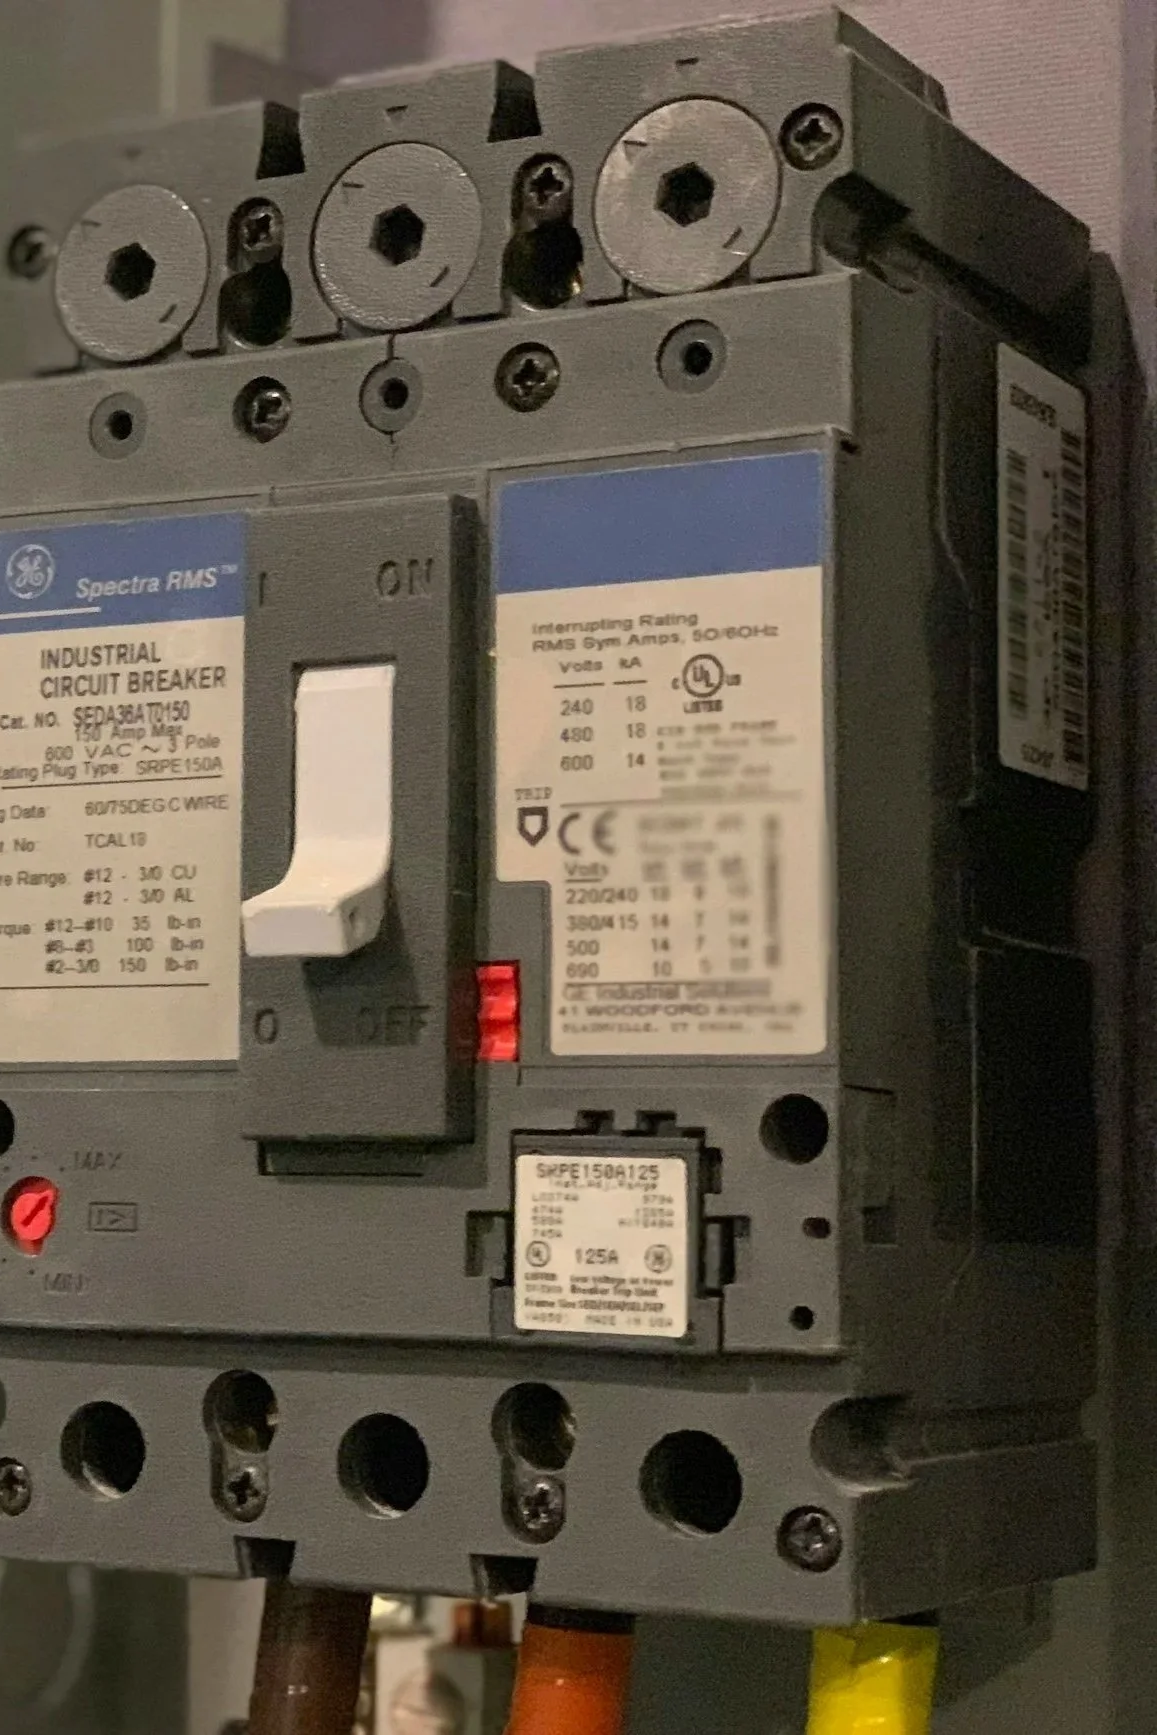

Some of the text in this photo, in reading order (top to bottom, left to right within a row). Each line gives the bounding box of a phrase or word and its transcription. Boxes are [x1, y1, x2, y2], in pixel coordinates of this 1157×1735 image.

[376, 557, 436, 597] ON
[75, 574, 160, 601] Spectra
[531, 612, 700, 636] Interrupting Rating
[531, 638, 577, 653] RMS
[582, 635, 622, 652] Sym
[40, 641, 162, 670] INDUSTRIAL
[559, 655, 643, 674] Volts kA
[39, 665, 227, 699] CIRCUIT BREAKER
[560, 695, 648, 717] 240 18
[110, 725, 147, 741] Amp
[151, 723, 184, 738] Max
[560, 725, 595, 744] 480
[626, 721, 648, 740] 18
[45, 745, 74, 762] 600
[84, 743, 132, 759] VAC
[185, 733, 221, 750] Pole
[43, 762, 77, 780] Plug
[560, 753, 595, 772] 600
[626, 751, 647, 769] 14
[184, 794, 230, 811] WIRE
[83, 867, 114, 884] #12
[170, 863, 198, 881] CU
[83, 889, 114, 905] #12
[173, 887, 196, 904] AL
[565, 886, 640, 906] 220/240
[131, 914, 152, 931] 35
[126, 936, 155, 953] 100
[566, 939, 601, 958] 500
[119, 957, 148, 974] 150
[566, 962, 600, 980] 690
[354, 1003, 431, 1046] OFF
[575, 1248, 619, 1265] 125A
